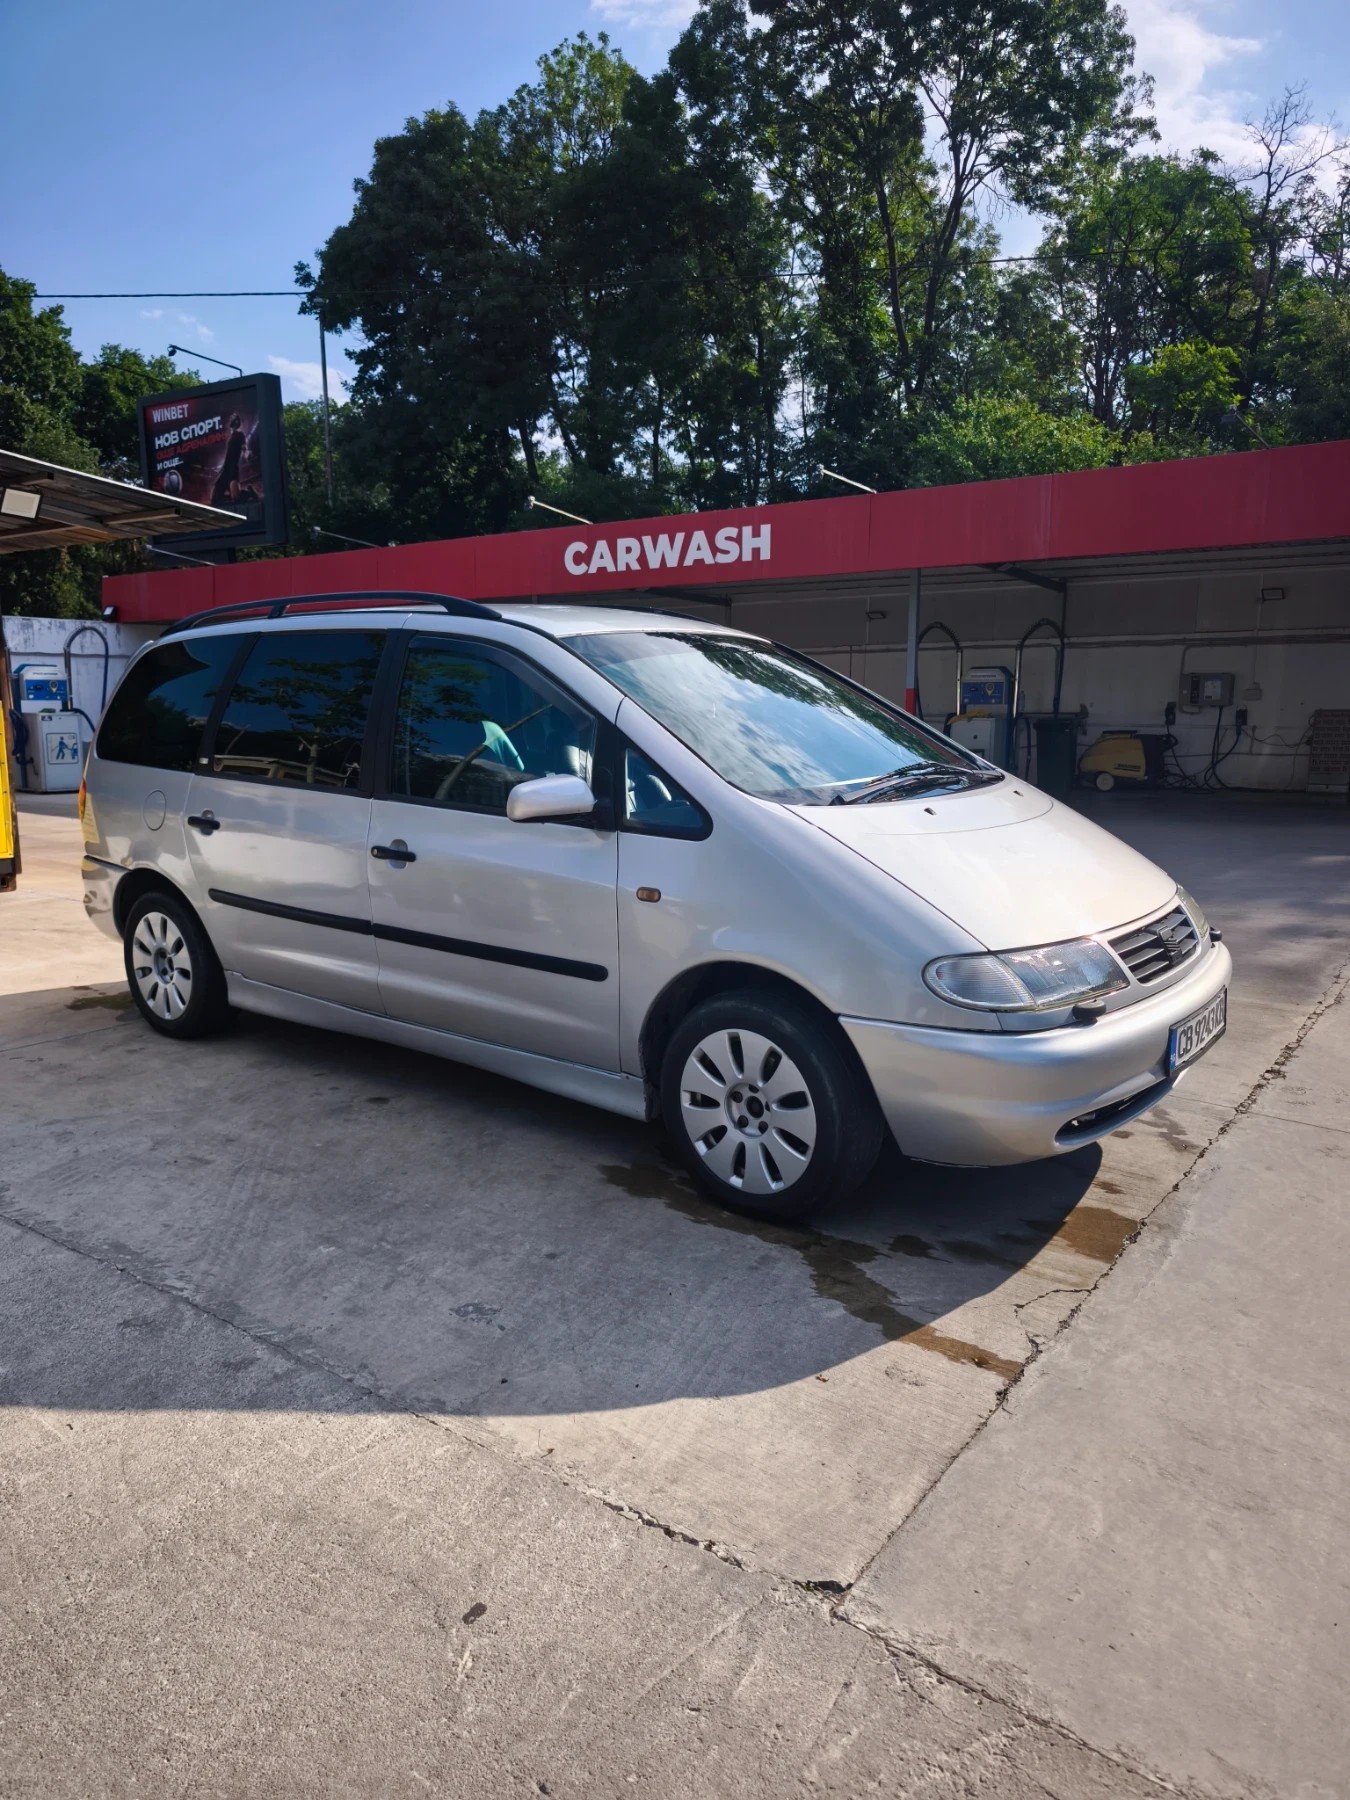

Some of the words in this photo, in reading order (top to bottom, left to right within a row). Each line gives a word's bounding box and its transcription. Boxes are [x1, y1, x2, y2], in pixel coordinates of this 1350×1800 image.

[152, 404, 189, 423] WINBET
[154, 431, 179, 450] НОВ
[181, 416, 223, 440] СПОРТ.
[564, 524, 771, 575] CARWASH
[1178, 1024, 1193, 1059] CB
